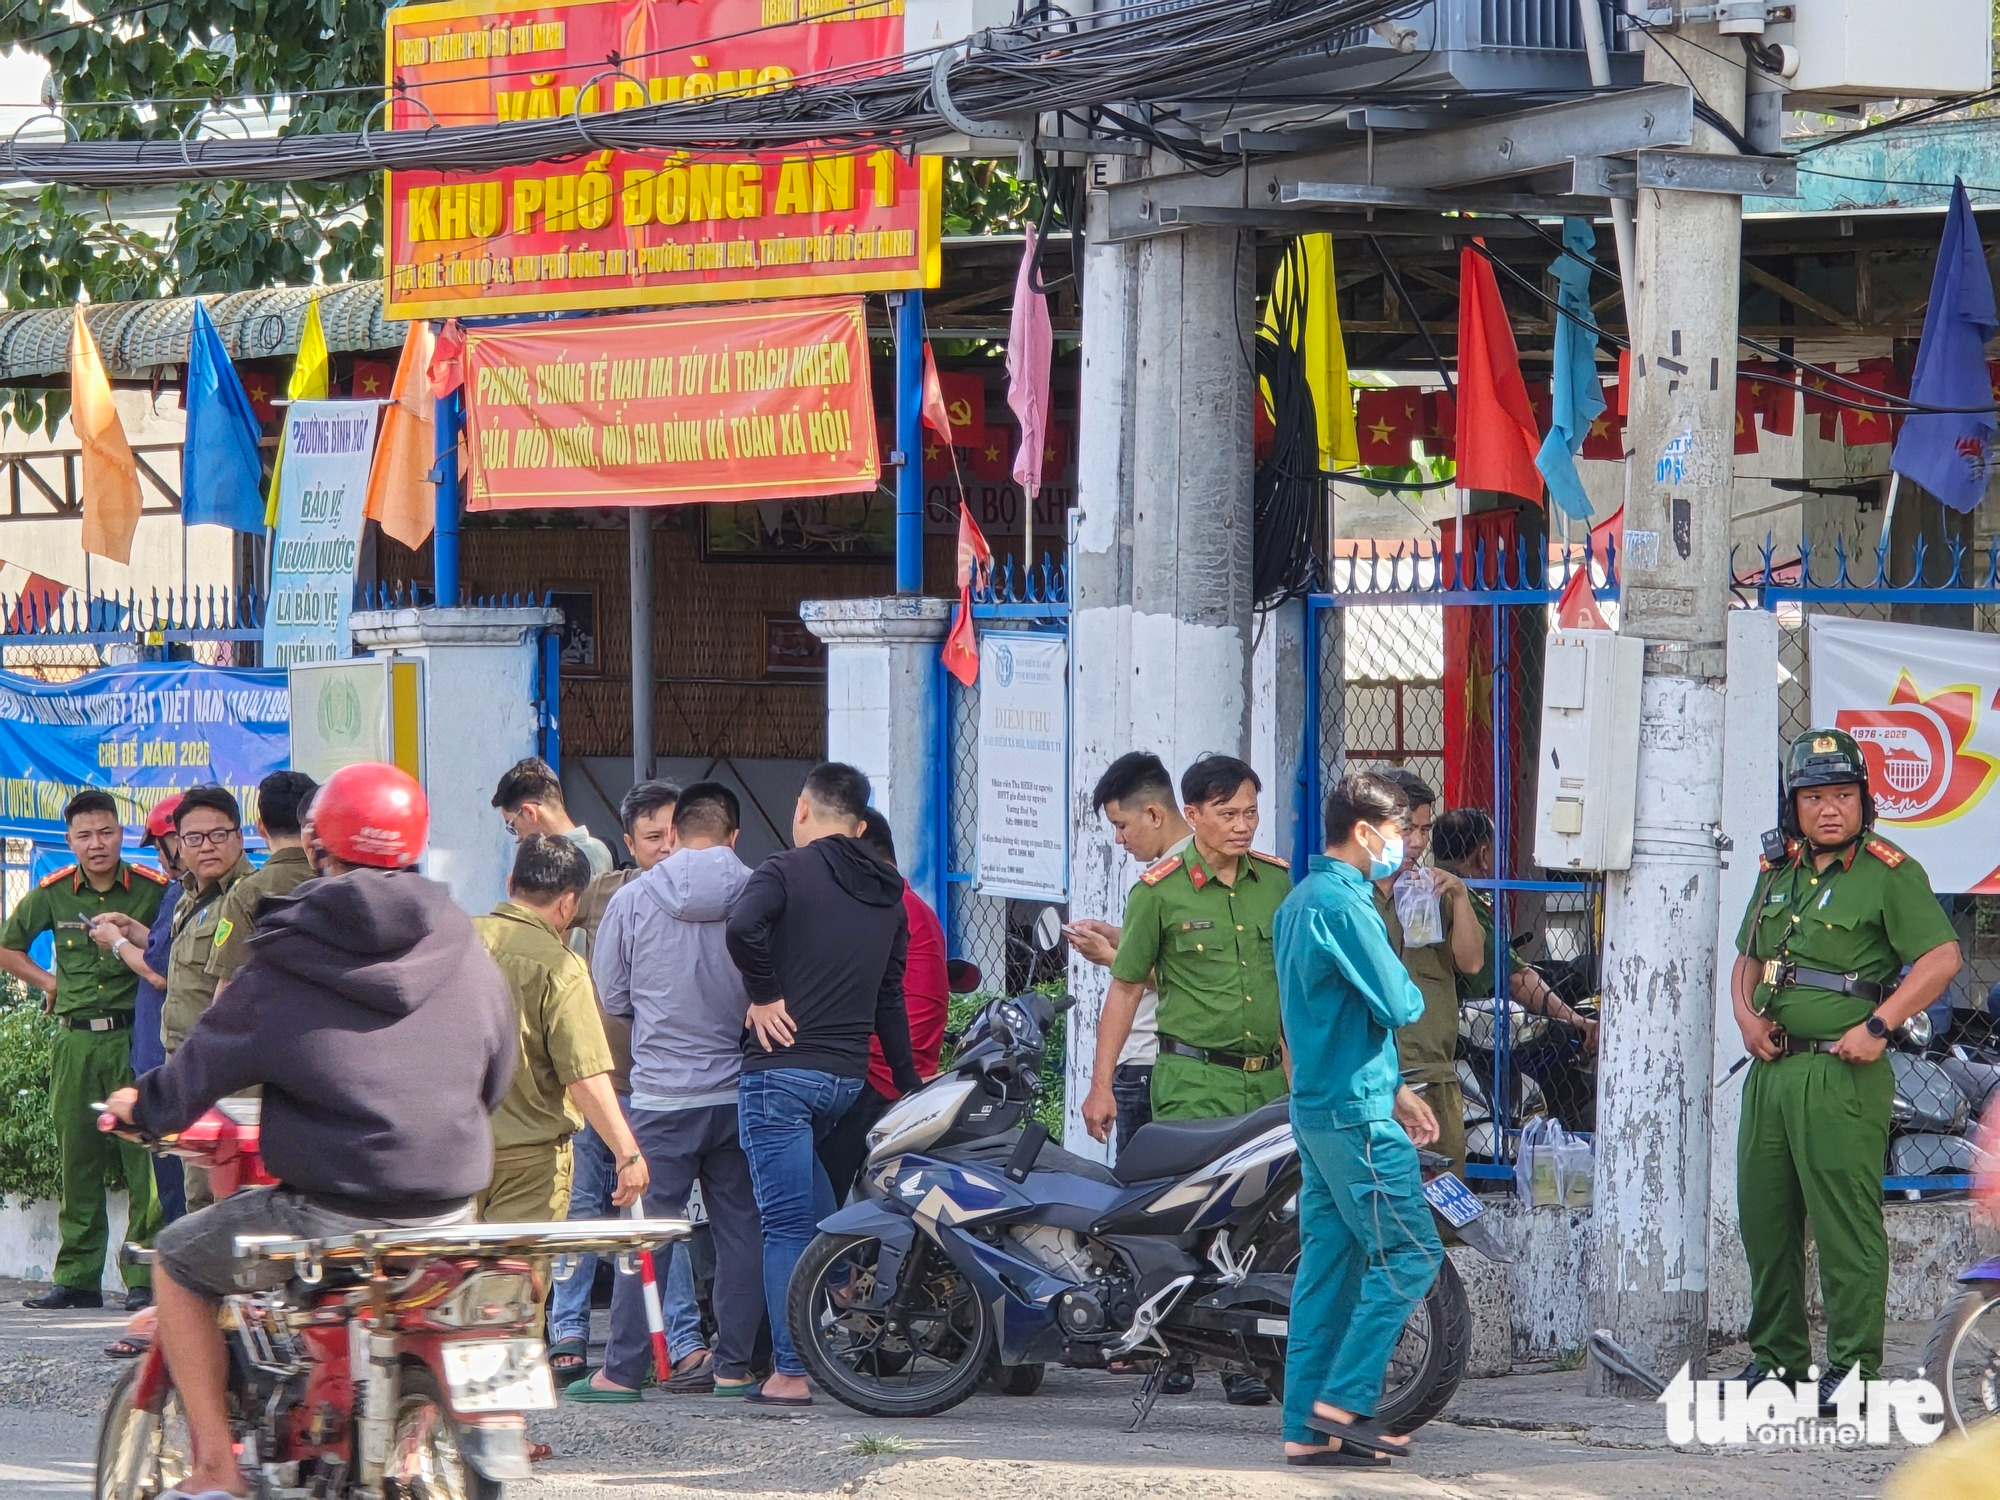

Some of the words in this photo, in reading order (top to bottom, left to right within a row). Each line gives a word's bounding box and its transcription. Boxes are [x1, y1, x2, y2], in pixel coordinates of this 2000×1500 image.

[429, 27, 468, 64] THÀNH
[468, 23, 492, 59] PHỐ
[491, 20, 510, 57] HỒ
[532, 21, 565, 51] MINH
[408, 181, 502, 242] KHU
[514, 149, 615, 235] PHỐ
[622, 150, 763, 227] ĐỒNG
[774, 153, 855, 215] AN
[866, 149, 895, 207] 1
[513, 255, 541, 282] KHU
[541, 244, 569, 281] PHỐ
[568, 242, 605, 278] ĐỒNG
[605, 249, 627, 275] AN
[638, 237, 694, 274] PHƯỜNG
[759, 232, 805, 266] THÀNH
[805, 224, 834, 262] PHỐ
[833, 223, 854, 261] HỒ
[854, 224, 878, 260] CHÍ
[877, 229, 916, 258] MINH
[477, 356, 532, 410] PHÒNG,
[536, 349, 585, 406] CHỐNG
[590, 352, 608, 411] TỆ
[609, 358, 646, 409] NẠN
[647, 356, 673, 398] MA
[678, 345, 708, 396] TÚY
[710, 343, 731, 394] LÀ
[735, 340, 789, 392] TRÁCH
[789, 334, 851, 395] NHIỆM
[293, 412, 329, 454] PHƯỜNG
[330, 413, 351, 454] BÌNH
[480, 416, 509, 470] CỦA
[550, 416, 601, 472] NGƯỜI,
[602, 410, 632, 466] MỖI
[634, 422, 662, 465] GIA
[663, 412, 704, 463] ĐÌNH
[706, 409, 729, 460] VÀ
[730, 407, 777, 459] TOÀN
[779, 404, 807, 456] XÃ
[807, 402, 852, 462] HỘI!
[300, 480, 329, 521] BẢO
[318, 534, 355, 573] NƯỚC
[276, 581, 291, 622] LÀ
[294, 583, 320, 622] BẢO
[324, 587, 338, 632] VỆ
[129, 685, 156, 731] TẬT
[158, 683, 191, 730] VIỆT
[194, 690, 224, 722] NAM
[98, 734, 119, 767] CHỦ
[142, 737, 176, 766] NĂM
[180, 741, 210, 767] 2026
[1852, 730, 1876, 739] 1976
[1884, 730, 1907, 739] 2026
